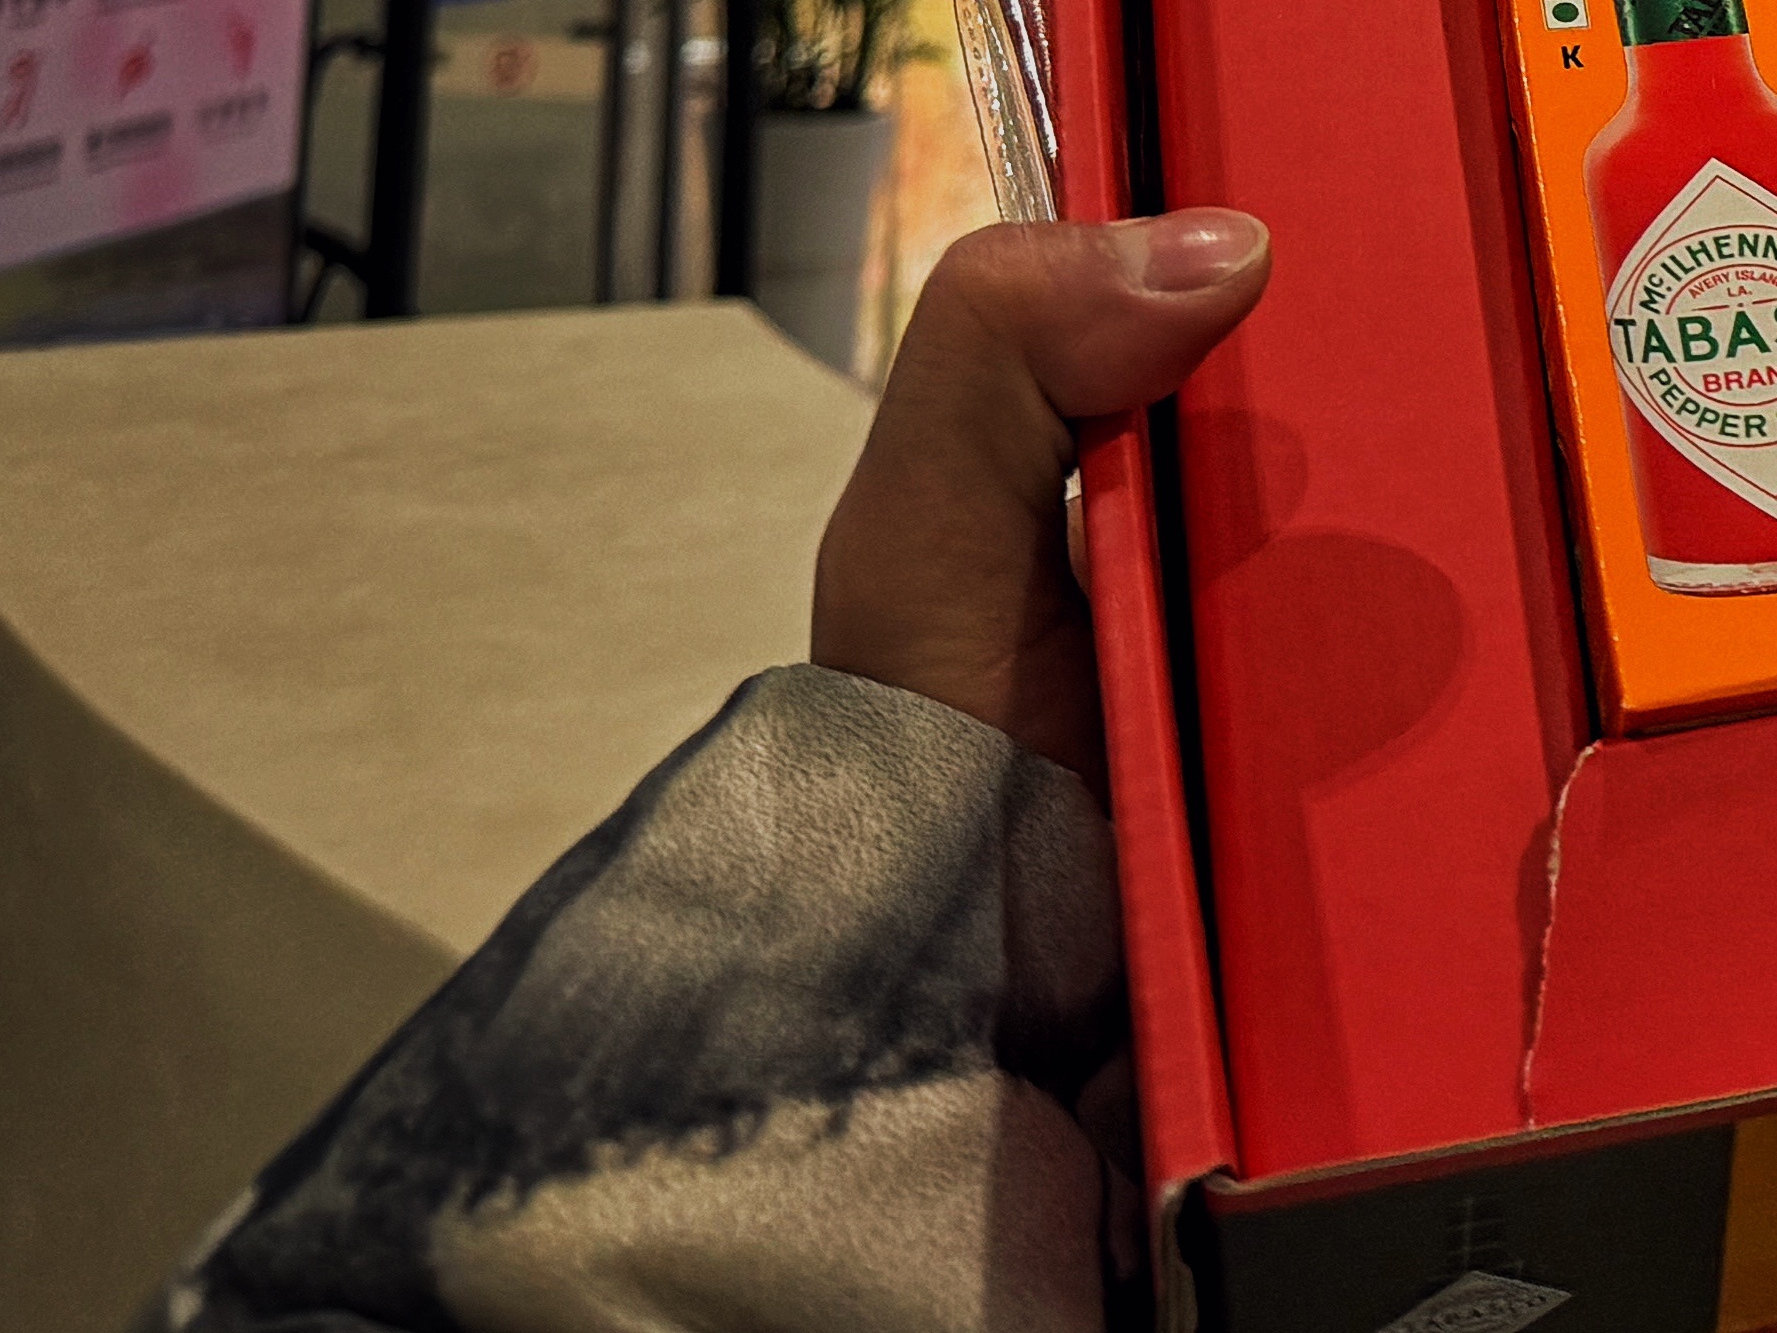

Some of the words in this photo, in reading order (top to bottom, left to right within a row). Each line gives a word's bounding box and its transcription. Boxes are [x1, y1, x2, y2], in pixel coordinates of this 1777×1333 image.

[1561, 45, 1584, 69] K
[1689, 272, 1730, 299] AVERY
[1727, 286, 1752, 297] LA.
[1649, 367, 1768, 438] PEPPER
